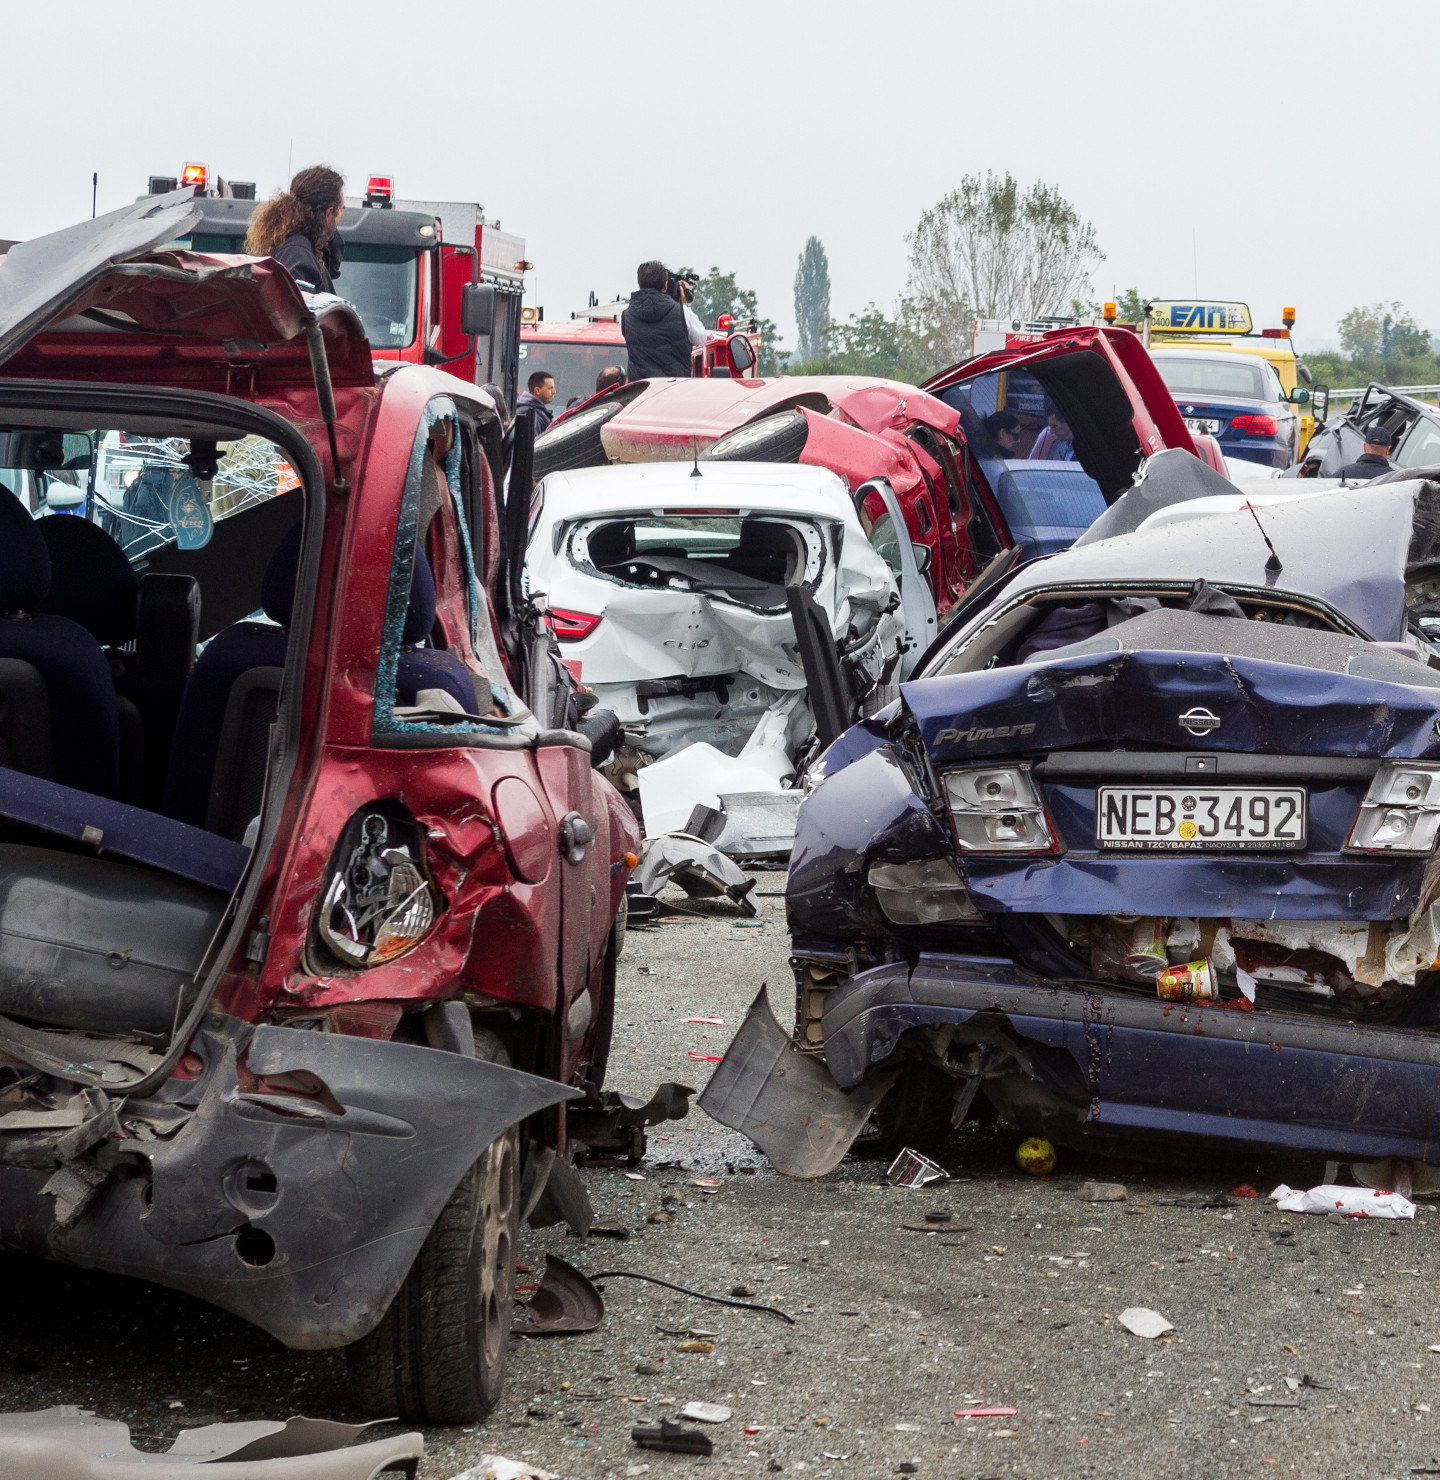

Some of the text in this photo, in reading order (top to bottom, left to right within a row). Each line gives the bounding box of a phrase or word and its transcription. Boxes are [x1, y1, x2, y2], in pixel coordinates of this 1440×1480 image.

[663, 639, 710, 651] CLIO
[1183, 718, 1216, 726] NISSAN
[933, 722, 1037, 746] Primera
[1106, 794, 1297, 838] NEB 3492
[1103, 840, 1143, 849] NISSAN
[1146, 841, 1203, 849] ΤΖΟΥΒΑΡΑΣ
